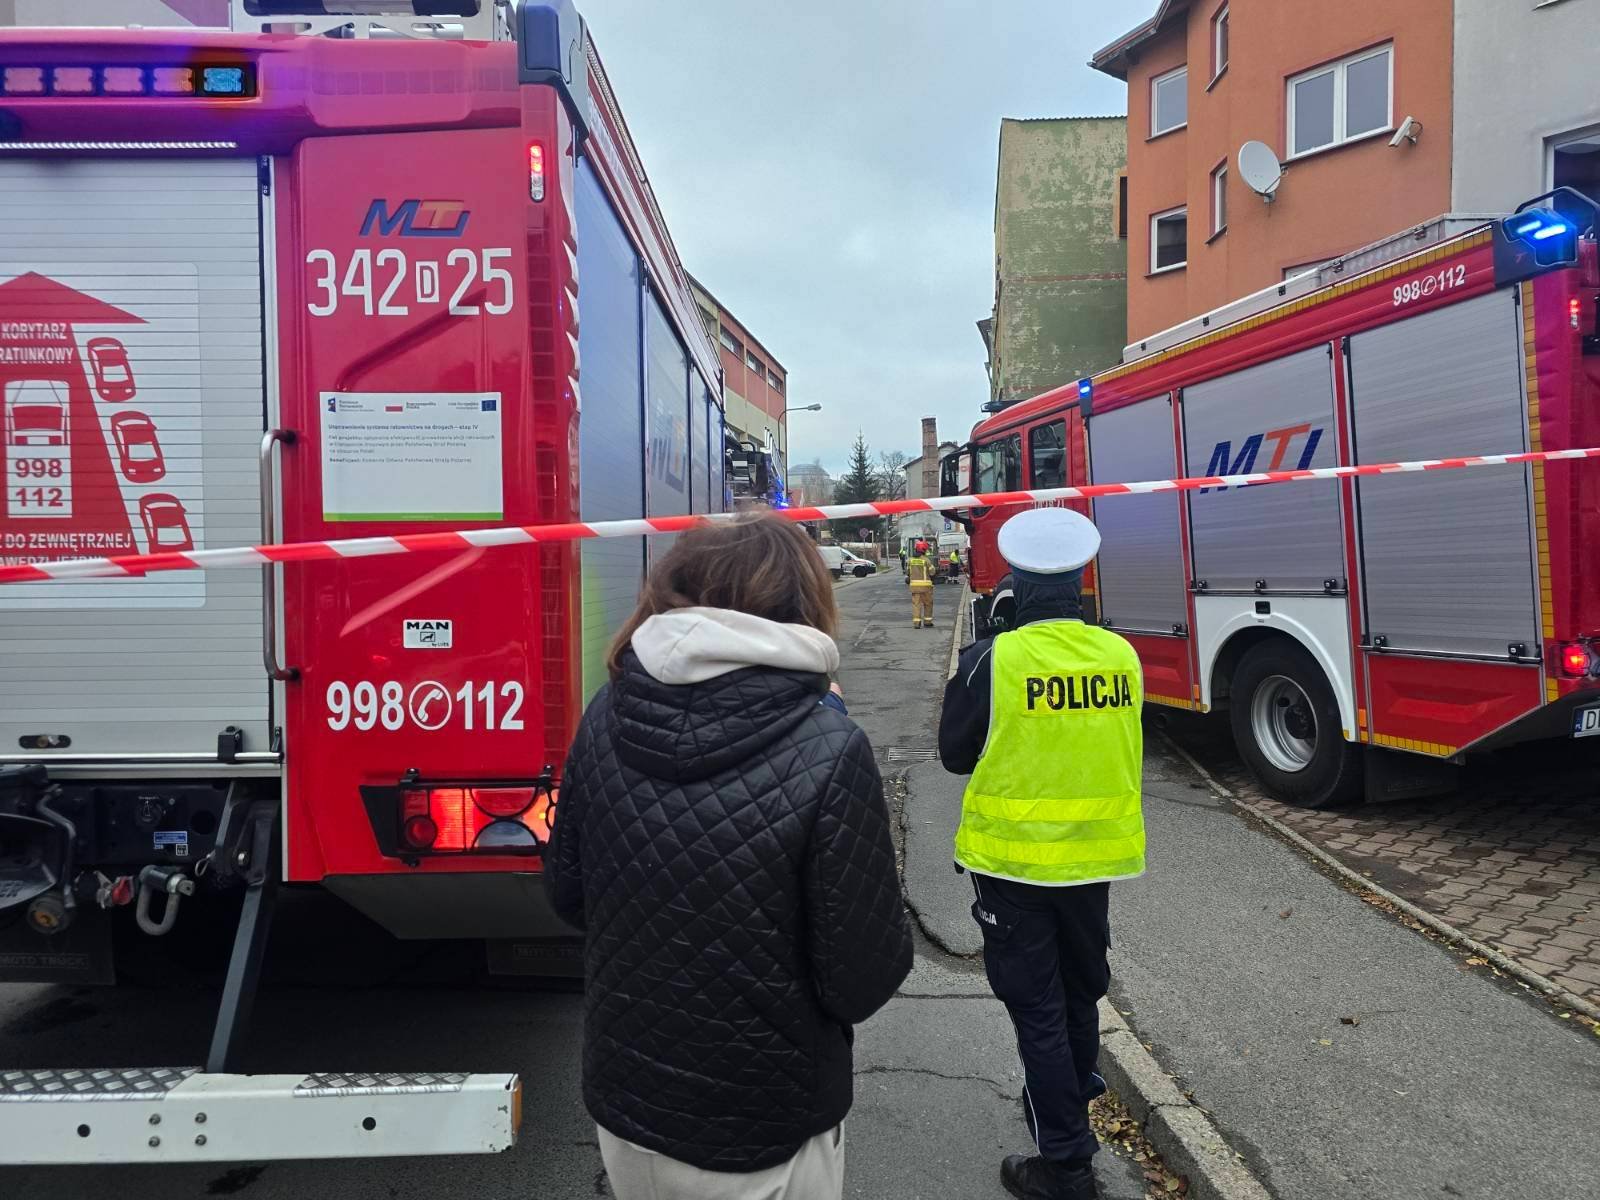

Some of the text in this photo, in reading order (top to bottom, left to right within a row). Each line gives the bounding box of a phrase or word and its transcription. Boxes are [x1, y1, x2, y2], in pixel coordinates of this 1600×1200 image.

[1393, 264, 1466, 306] 998 112
[1, 322, 68, 340] KORYTARZ
[15, 458, 63, 478] 998
[15, 487, 63, 507] 112
[5, 533, 26, 549] DO
[28, 533, 131, 552] ZEWNĘTRZNEJ
[406, 621, 449, 630] MAN
[1026, 674, 1133, 711] POLICJA
[326, 680, 524, 731] 998 112
